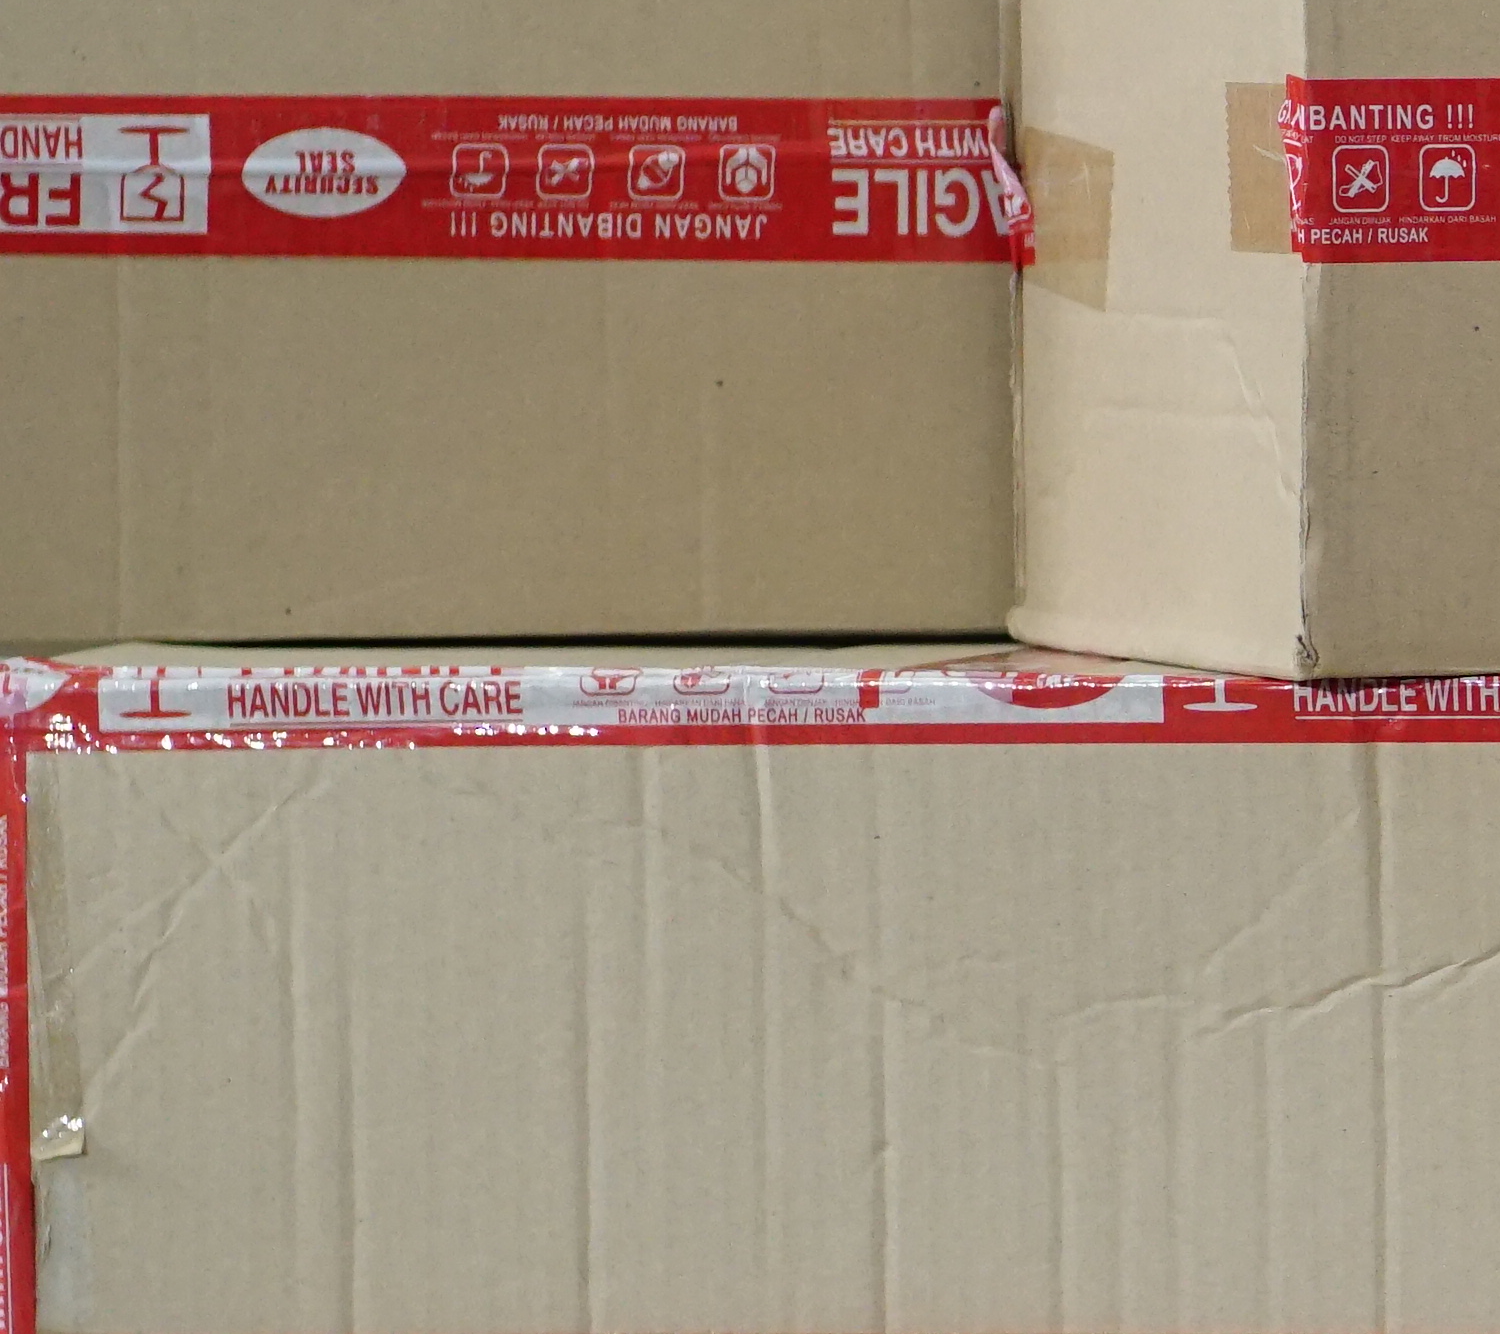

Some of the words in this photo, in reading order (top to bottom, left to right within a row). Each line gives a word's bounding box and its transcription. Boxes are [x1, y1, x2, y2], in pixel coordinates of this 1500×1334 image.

[498, 114, 551, 132] RUSAK
[564, 114, 614, 132] PECAH
[619, 114, 672, 132] MUDAH
[677, 114, 739, 132] BARANG
[827, 126, 909, 158] CARE
[914, 126, 991, 158] WITH
[296, 149, 356, 174] SEAL
[264, 174, 380, 197] SECURITY
[490, 212, 642, 239] DIBANTING
[655, 212, 767, 239] JANGAN
[1311, 227, 1363, 244] PECAH
[1378, 227, 1429, 244] RUSAK
[227, 679, 349, 718] HANDLE
[355, 679, 433, 718] WITH
[440, 679, 524, 718] CARE
[1293, 678, 1418, 713] HANDLE
[1424, 676, 1500, 713] WITH
[618, 707, 681, 724] BARANG
[687, 707, 741, 724] MUDAH
[749, 707, 798, 724] PECAH
[814, 707, 867, 724] RUSAK
